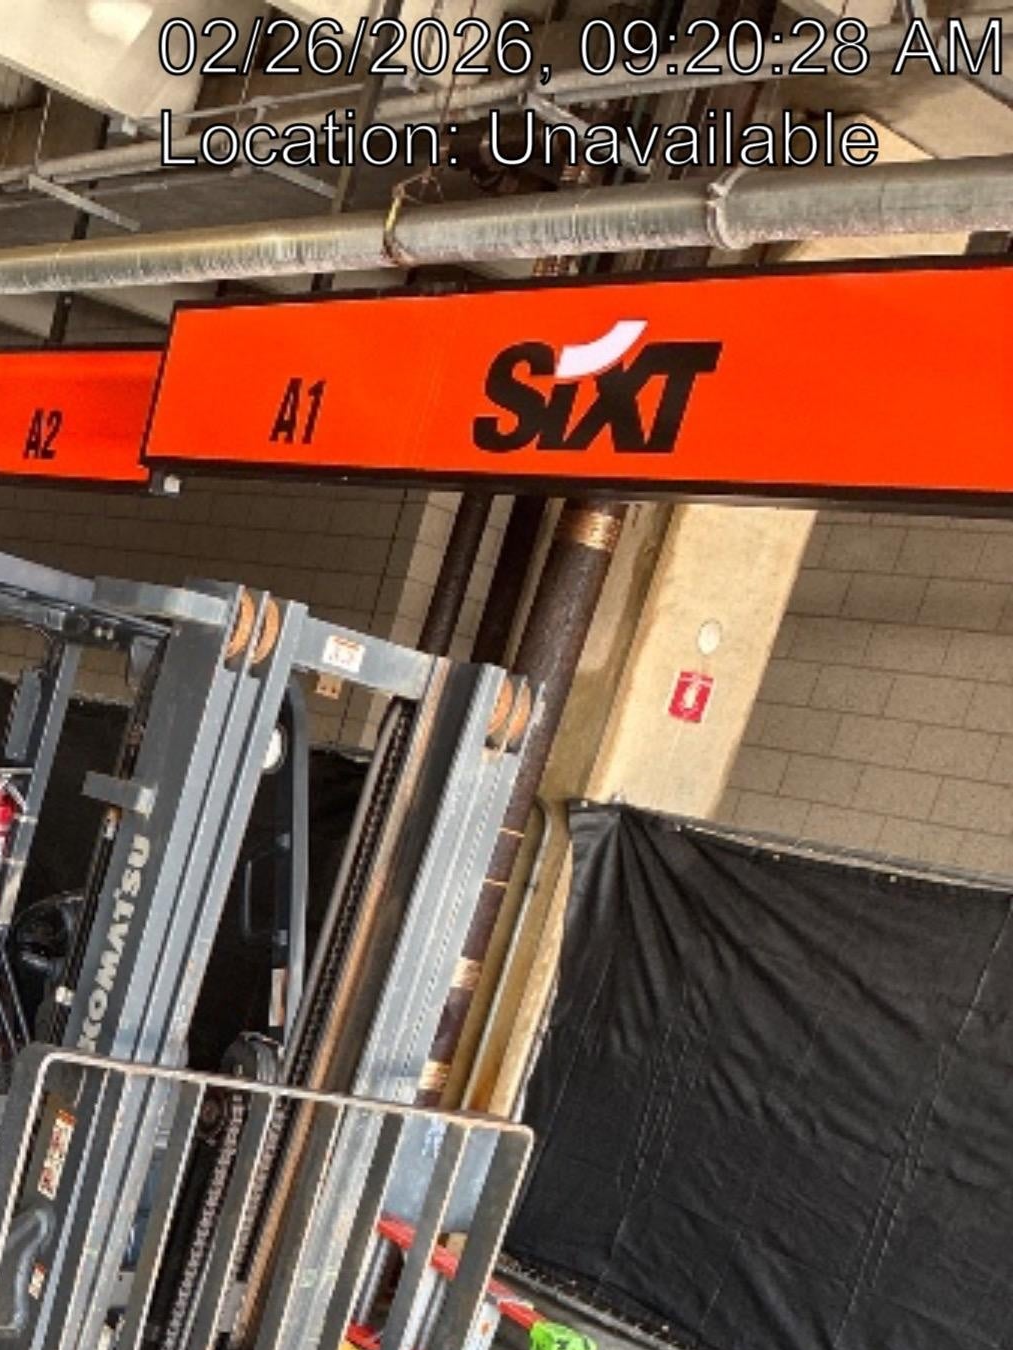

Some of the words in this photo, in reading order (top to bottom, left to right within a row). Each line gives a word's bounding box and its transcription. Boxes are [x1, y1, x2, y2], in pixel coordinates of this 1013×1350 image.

[23, 409, 64, 460] A2
[269, 378, 326, 444] A1
[76, 833, 151, 1052] KOMATSU
